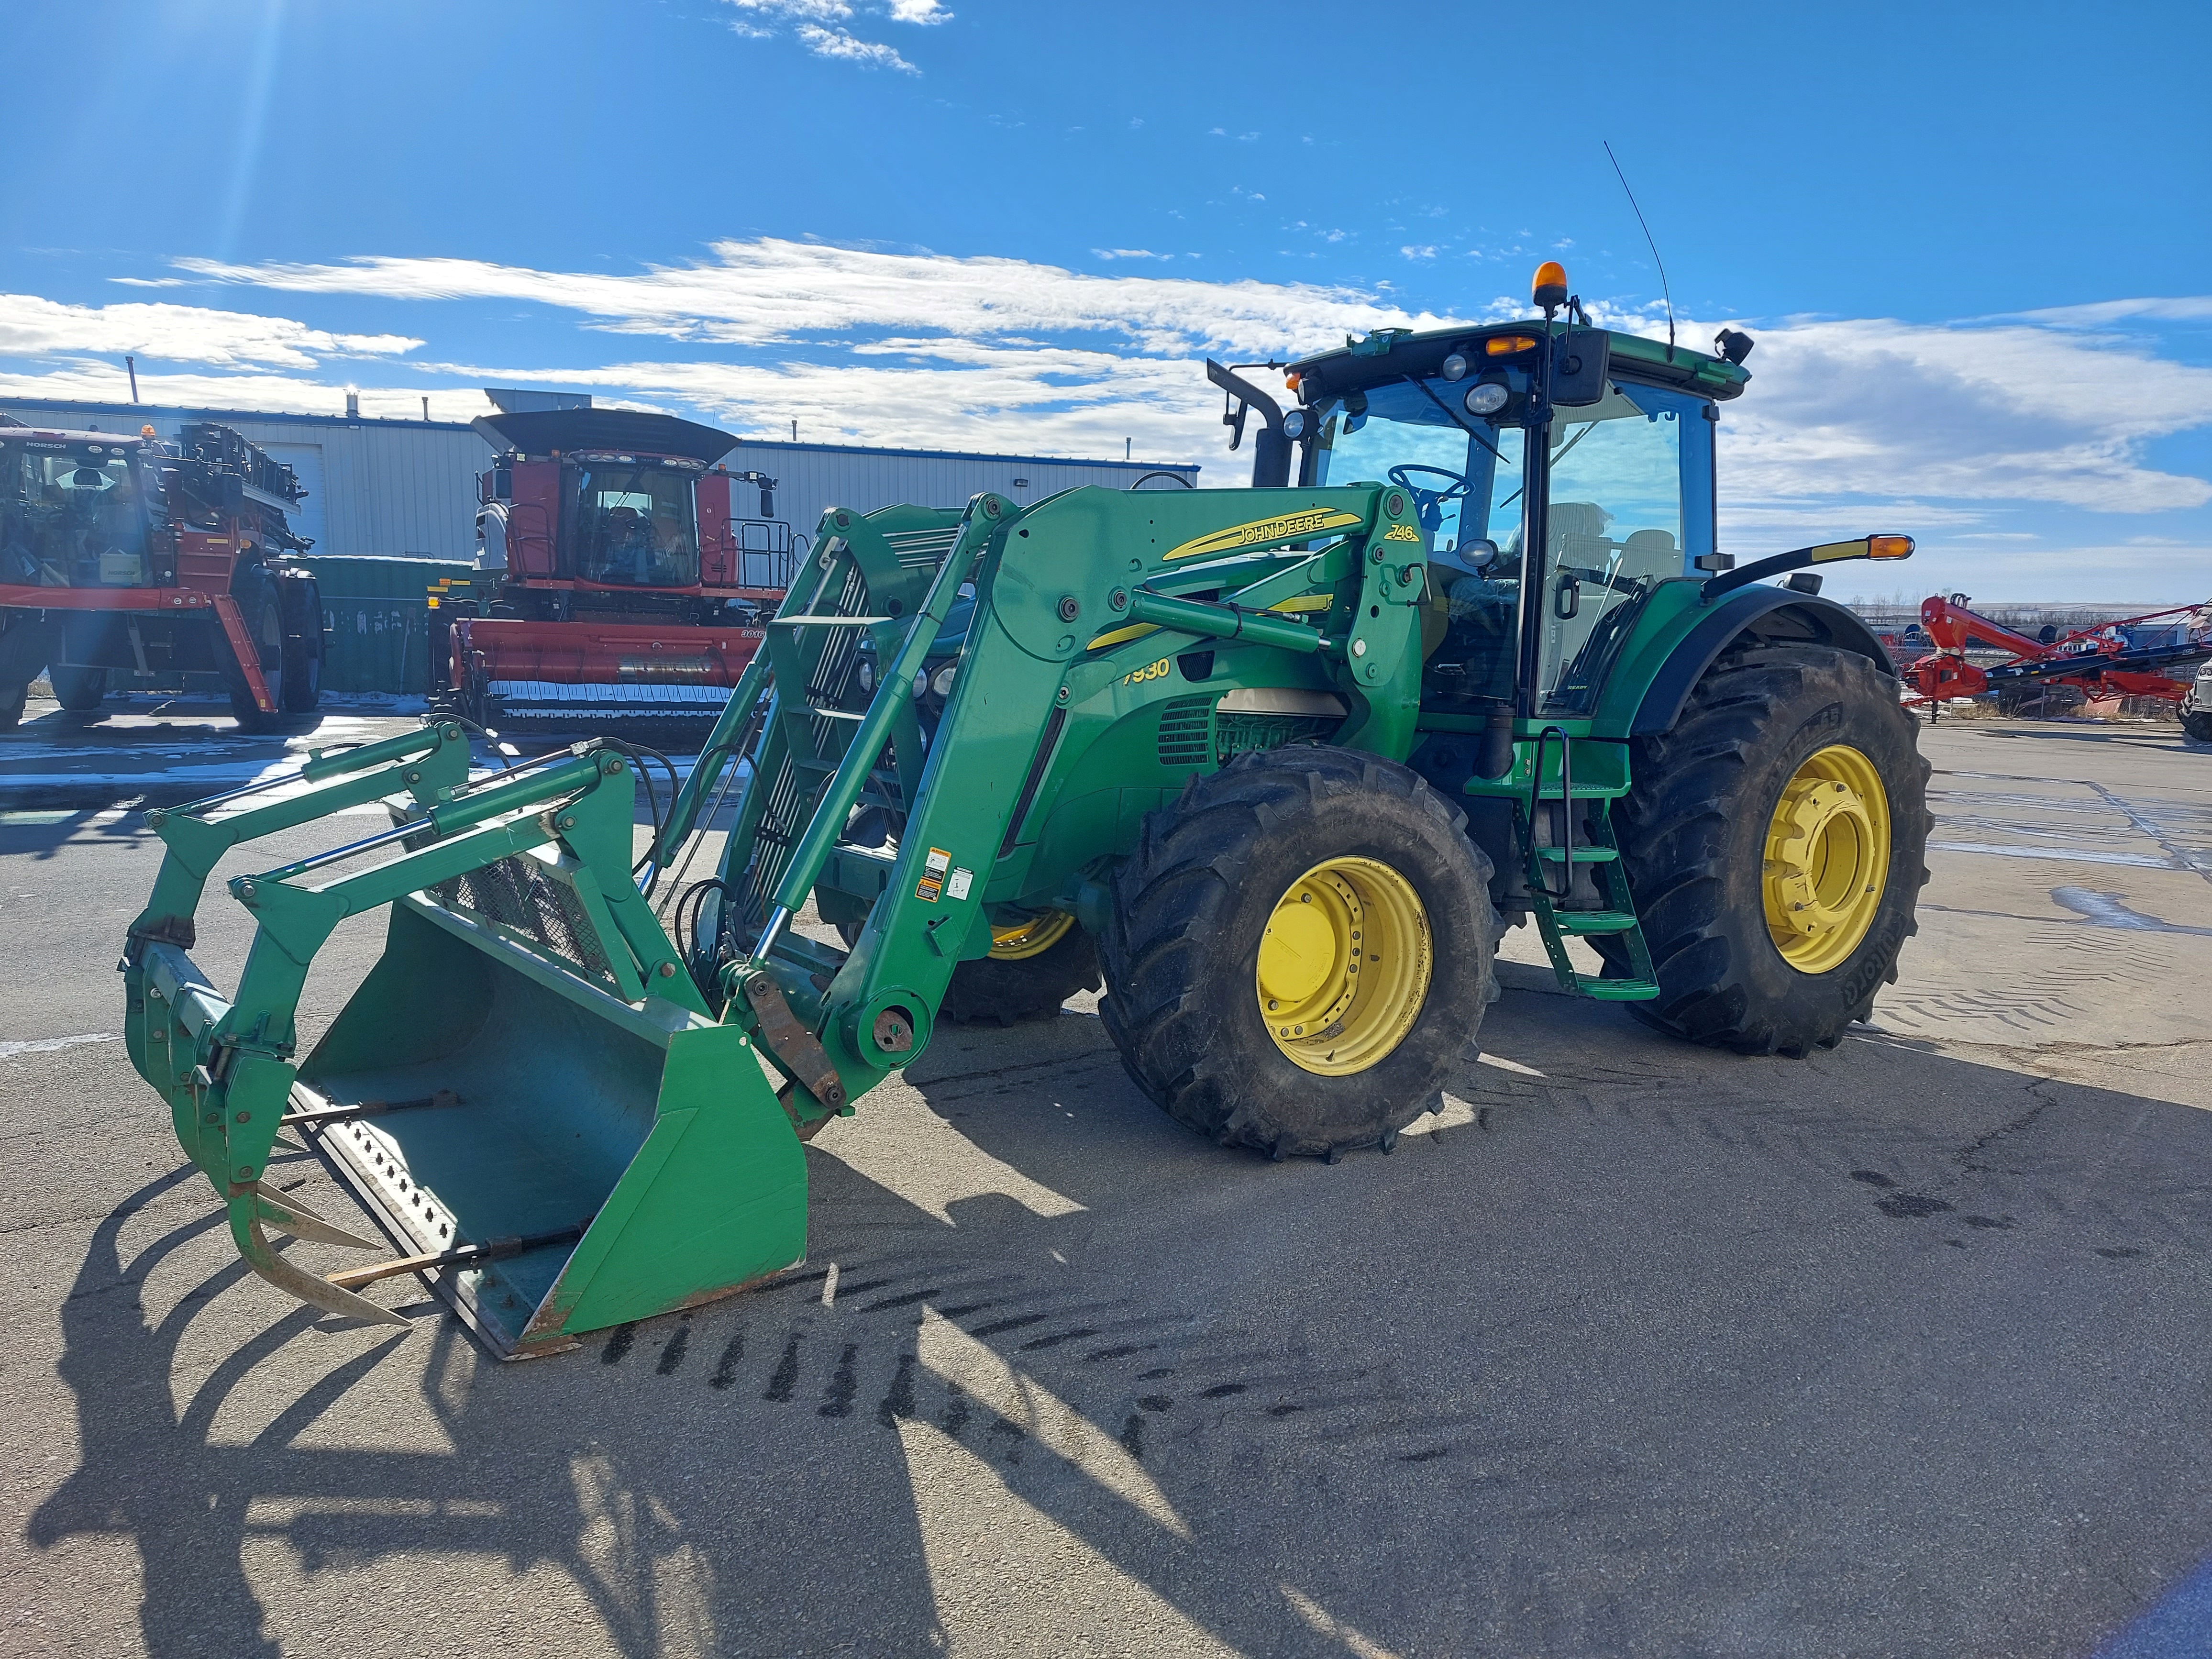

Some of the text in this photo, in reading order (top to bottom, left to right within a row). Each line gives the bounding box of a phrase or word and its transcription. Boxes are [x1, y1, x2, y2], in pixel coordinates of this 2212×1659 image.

[1238, 514, 1324, 544] JOHN DEERE
[1391, 524, 1413, 540] 746
[741, 630, 765, 638] 3016
